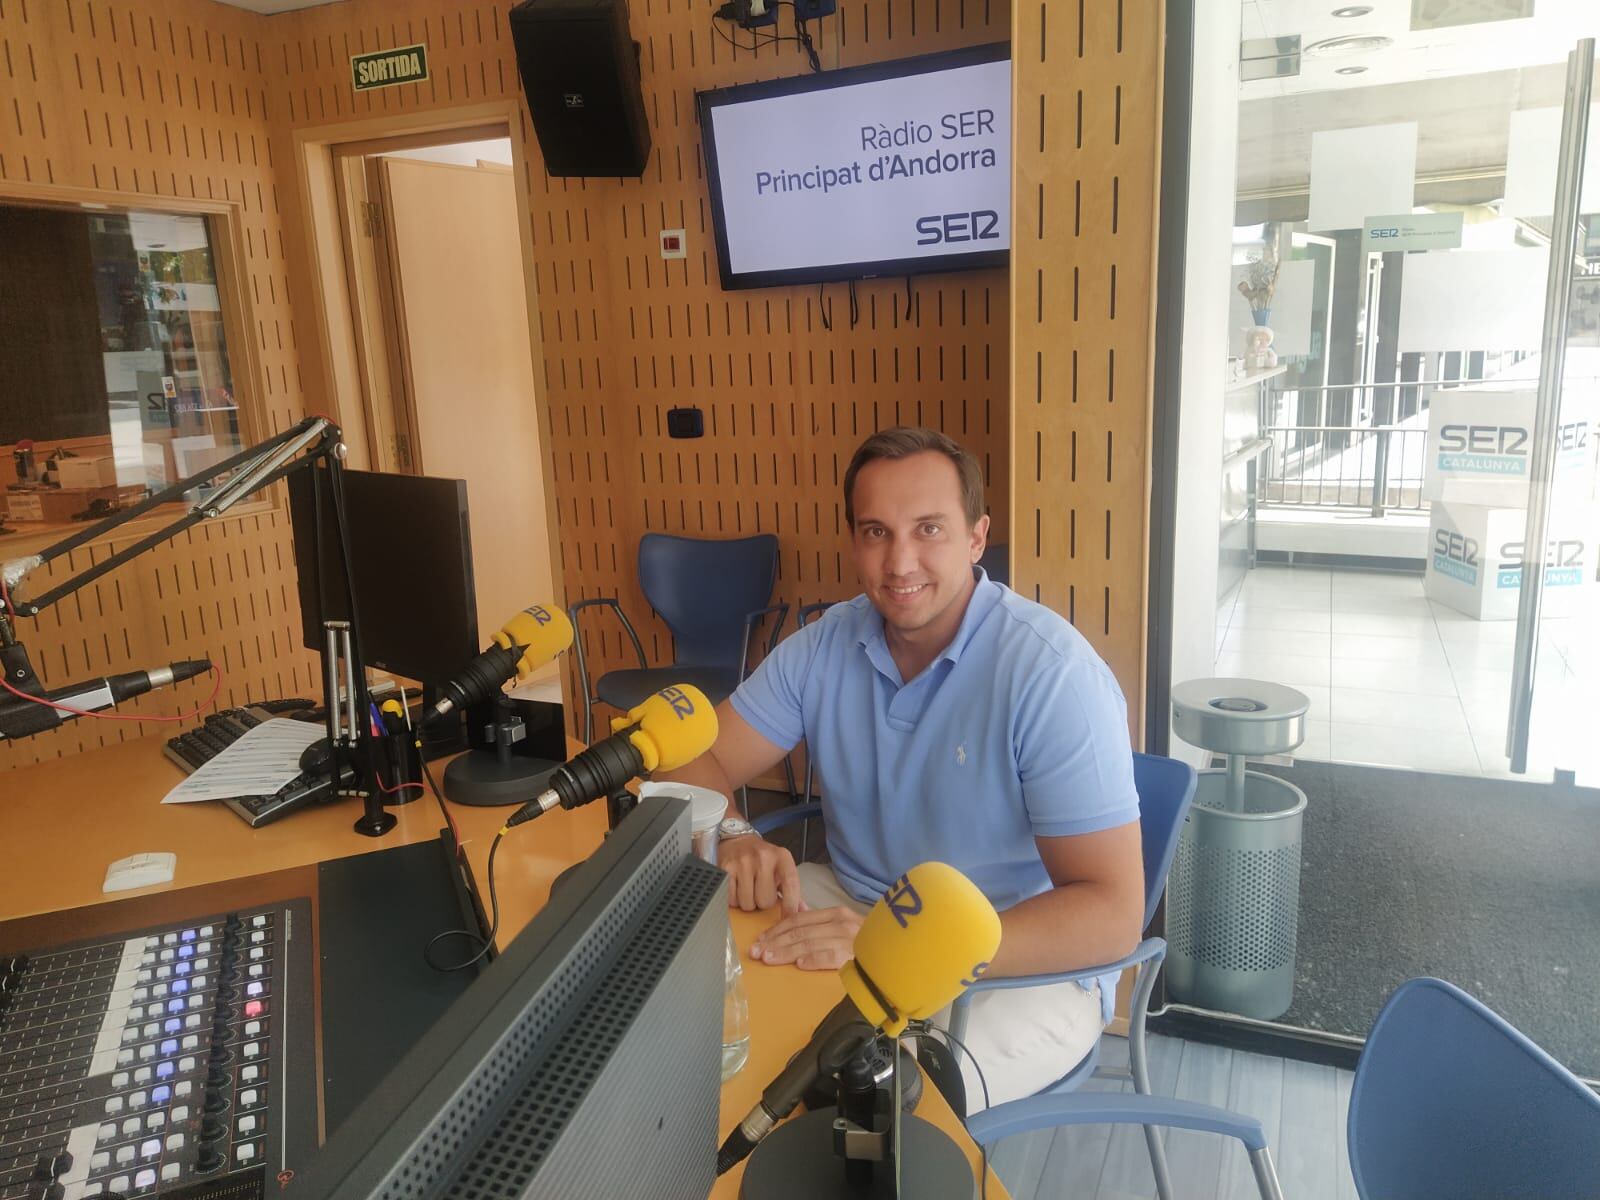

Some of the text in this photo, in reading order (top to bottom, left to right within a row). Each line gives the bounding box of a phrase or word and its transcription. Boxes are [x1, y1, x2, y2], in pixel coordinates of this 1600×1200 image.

[358, 52, 422, 84] SORTIDA
[860, 108, 995, 151] Ràdio SER
[756, 160, 862, 195] Principat
[915, 209, 1001, 246] SER
[1370, 228, 1400, 239] SER
[1439, 424, 1528, 456] SER
[1442, 456, 1521, 472] CATALUNYA
[1434, 528, 1479, 567] SER
[523, 605, 552, 626] ER
[657, 687, 695, 721] ER
